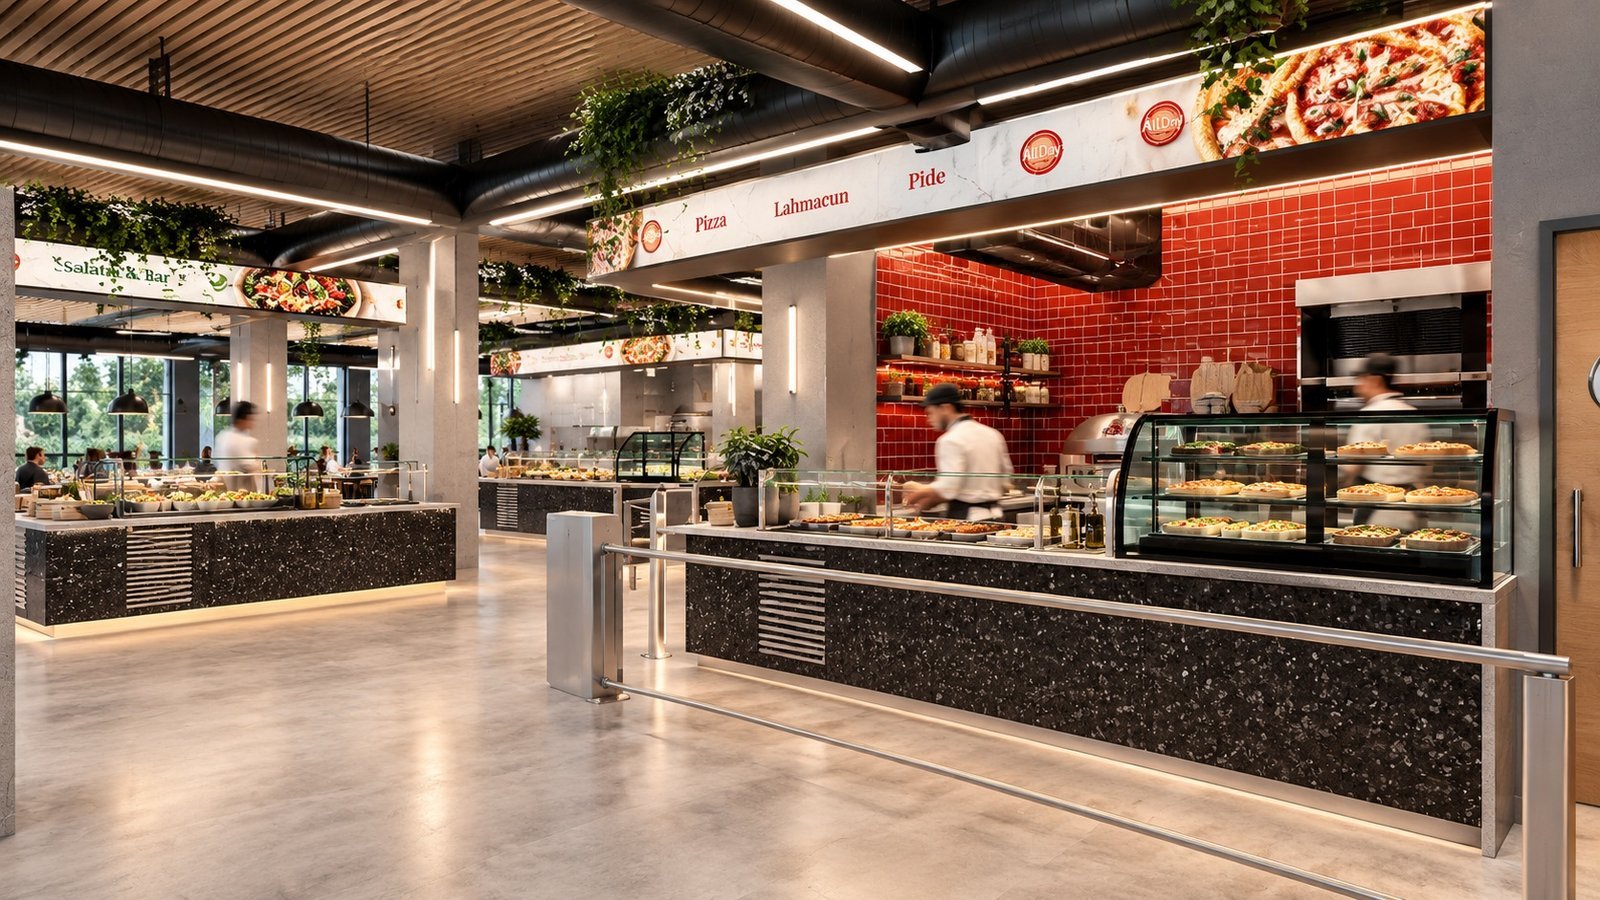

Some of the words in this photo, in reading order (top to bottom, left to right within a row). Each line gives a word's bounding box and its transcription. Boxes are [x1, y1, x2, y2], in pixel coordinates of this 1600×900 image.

[909, 168, 946, 190] Pide
[774, 189, 849, 217] Lahmacun
[695, 213, 727, 232] Pizza
[145, 269, 170, 283] Bar
